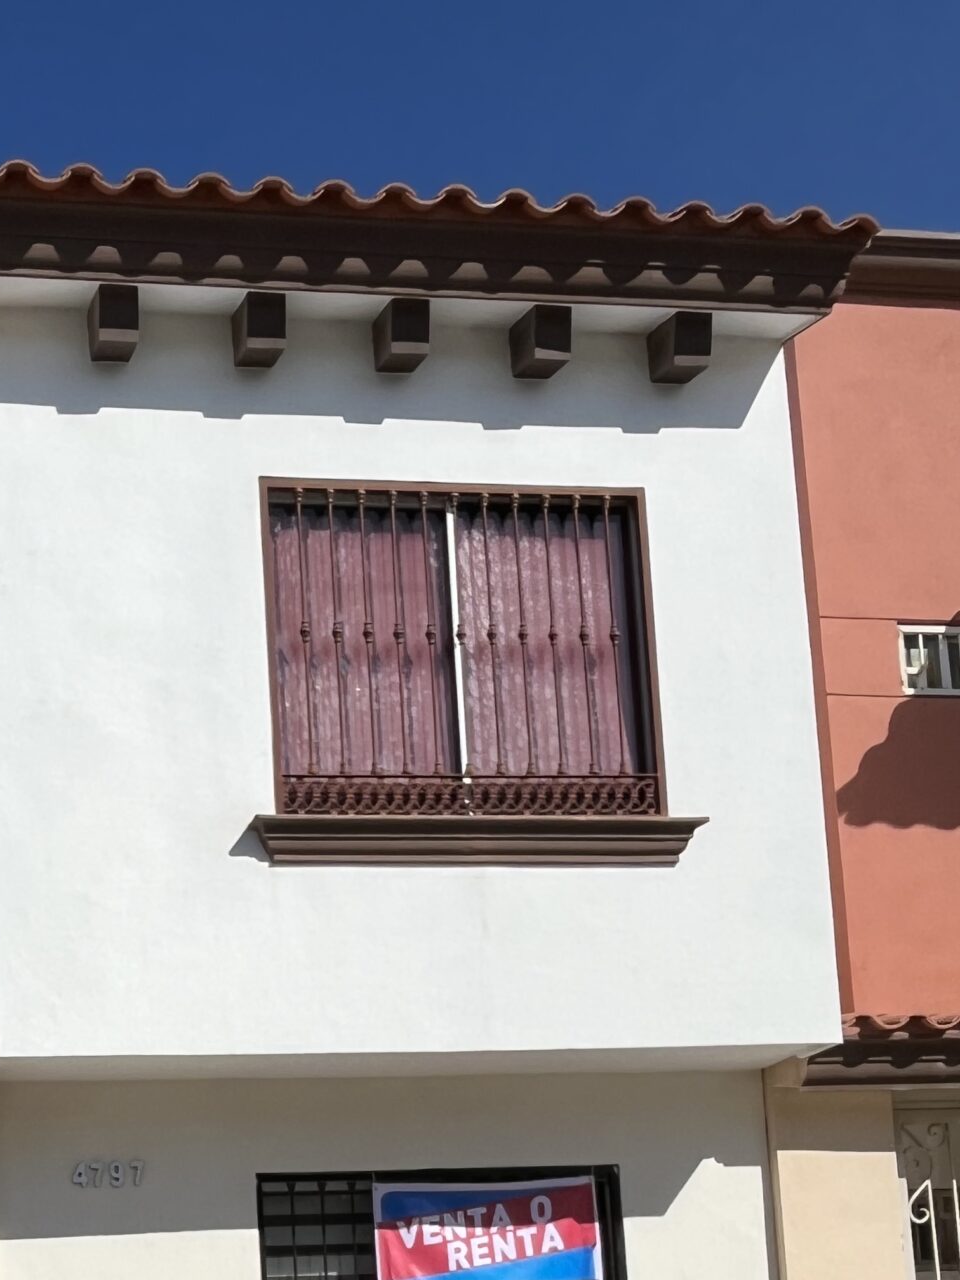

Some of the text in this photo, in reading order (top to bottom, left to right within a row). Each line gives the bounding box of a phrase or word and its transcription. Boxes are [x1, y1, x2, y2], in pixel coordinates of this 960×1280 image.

[72, 1159, 145, 1188] 4797
[397, 1195, 552, 1249] VENTA O
[447, 1223, 565, 1272] RENTA
